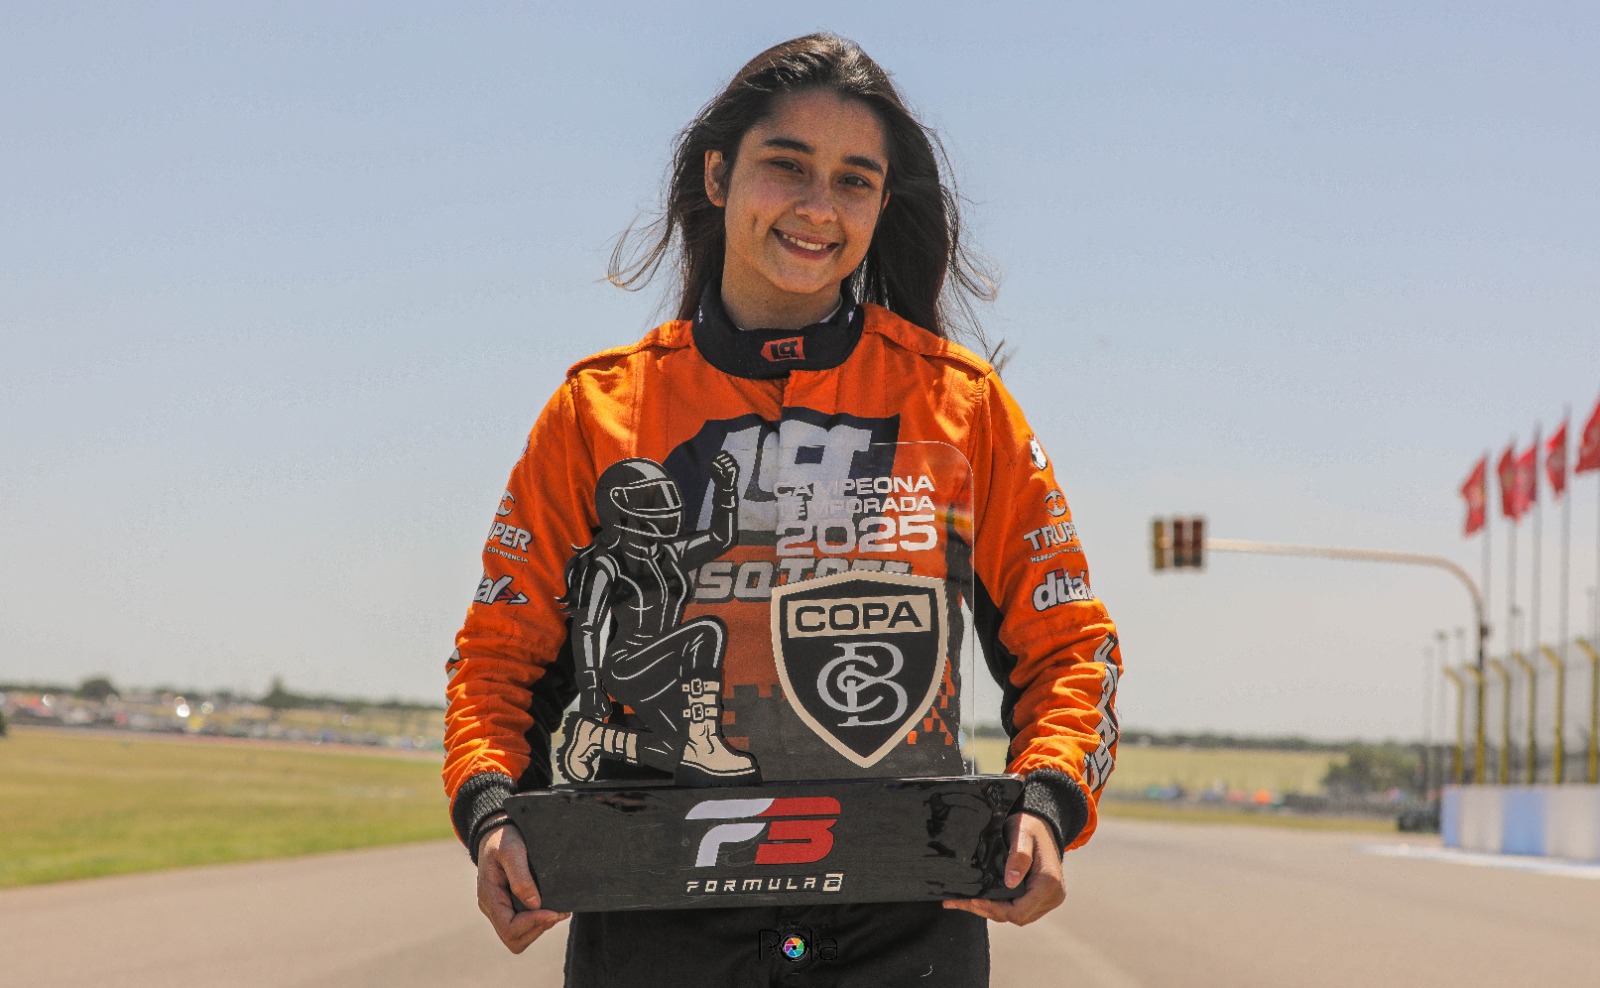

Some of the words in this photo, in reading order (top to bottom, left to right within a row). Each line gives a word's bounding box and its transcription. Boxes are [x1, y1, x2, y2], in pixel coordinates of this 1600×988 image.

[774, 475, 935, 498] CAMPEONA
[776, 514, 938, 556] 2025
[795, 601, 923, 633] COPA
[686, 877, 818, 893] FORMULA
